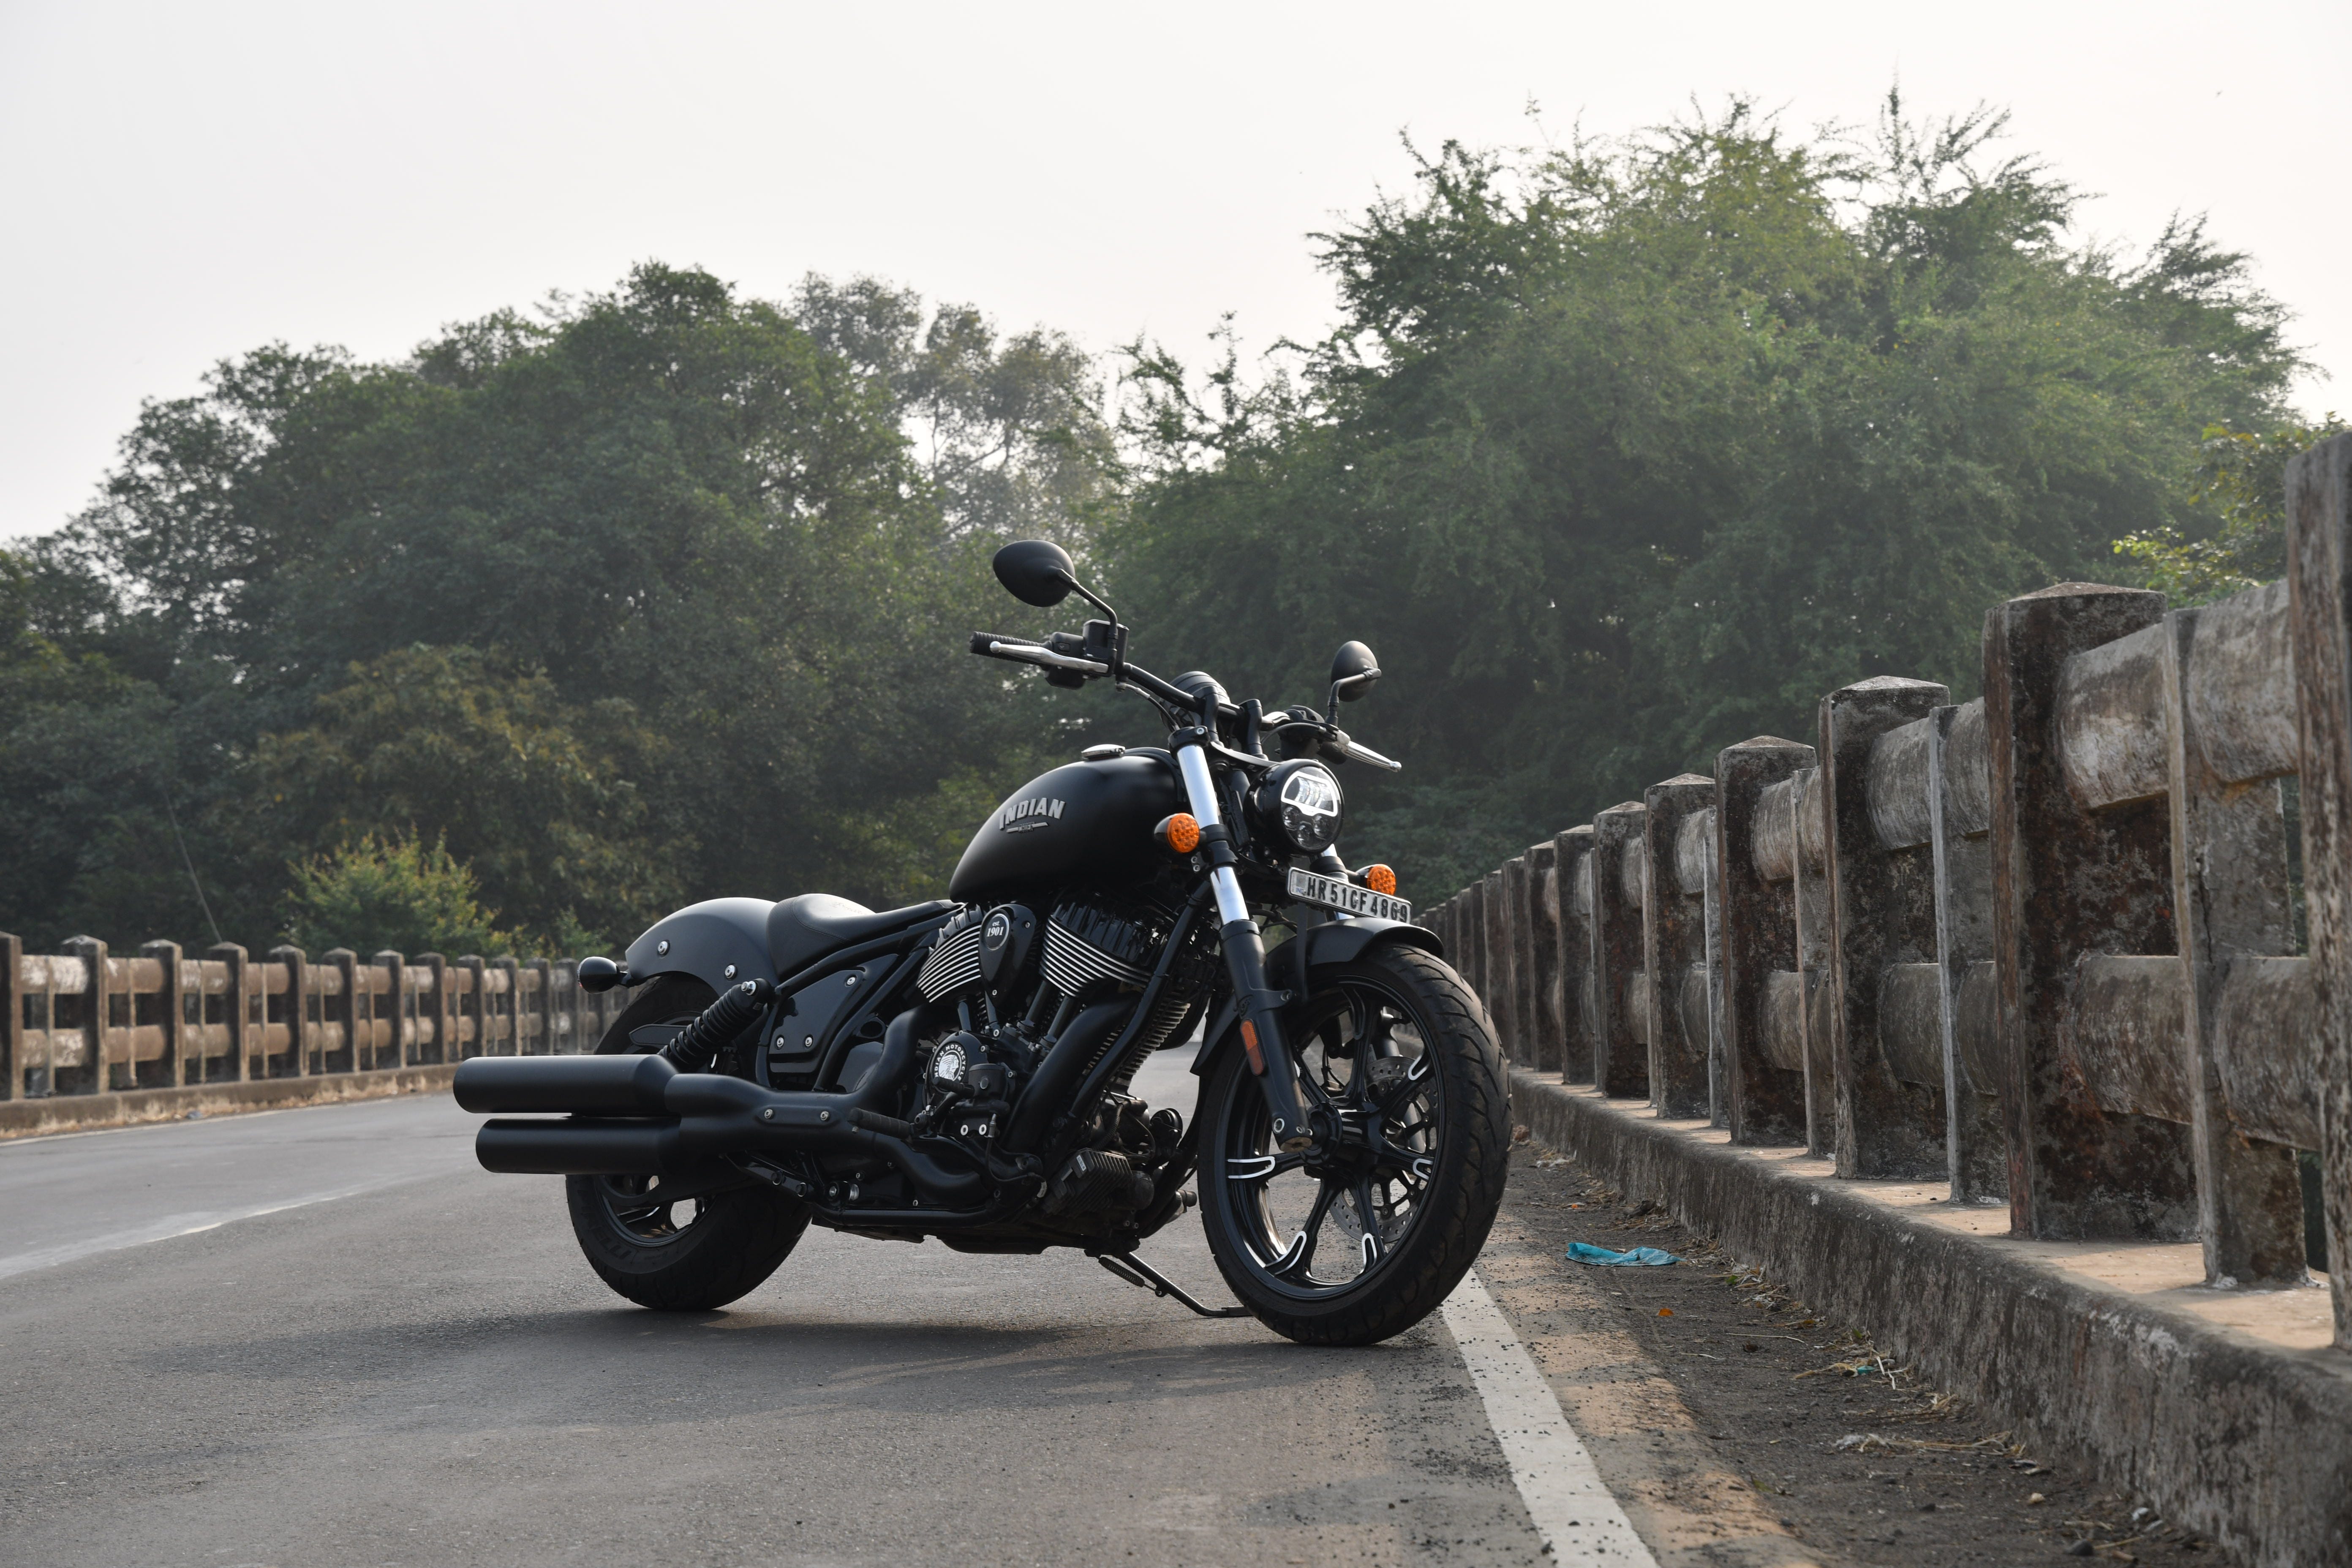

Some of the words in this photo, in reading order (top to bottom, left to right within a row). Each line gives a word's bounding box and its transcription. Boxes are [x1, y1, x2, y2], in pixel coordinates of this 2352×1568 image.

[999, 798, 1066, 830] INDIAN
[987, 927, 1004, 936] 1901
[934, 1051, 944, 1077] NDIAN
